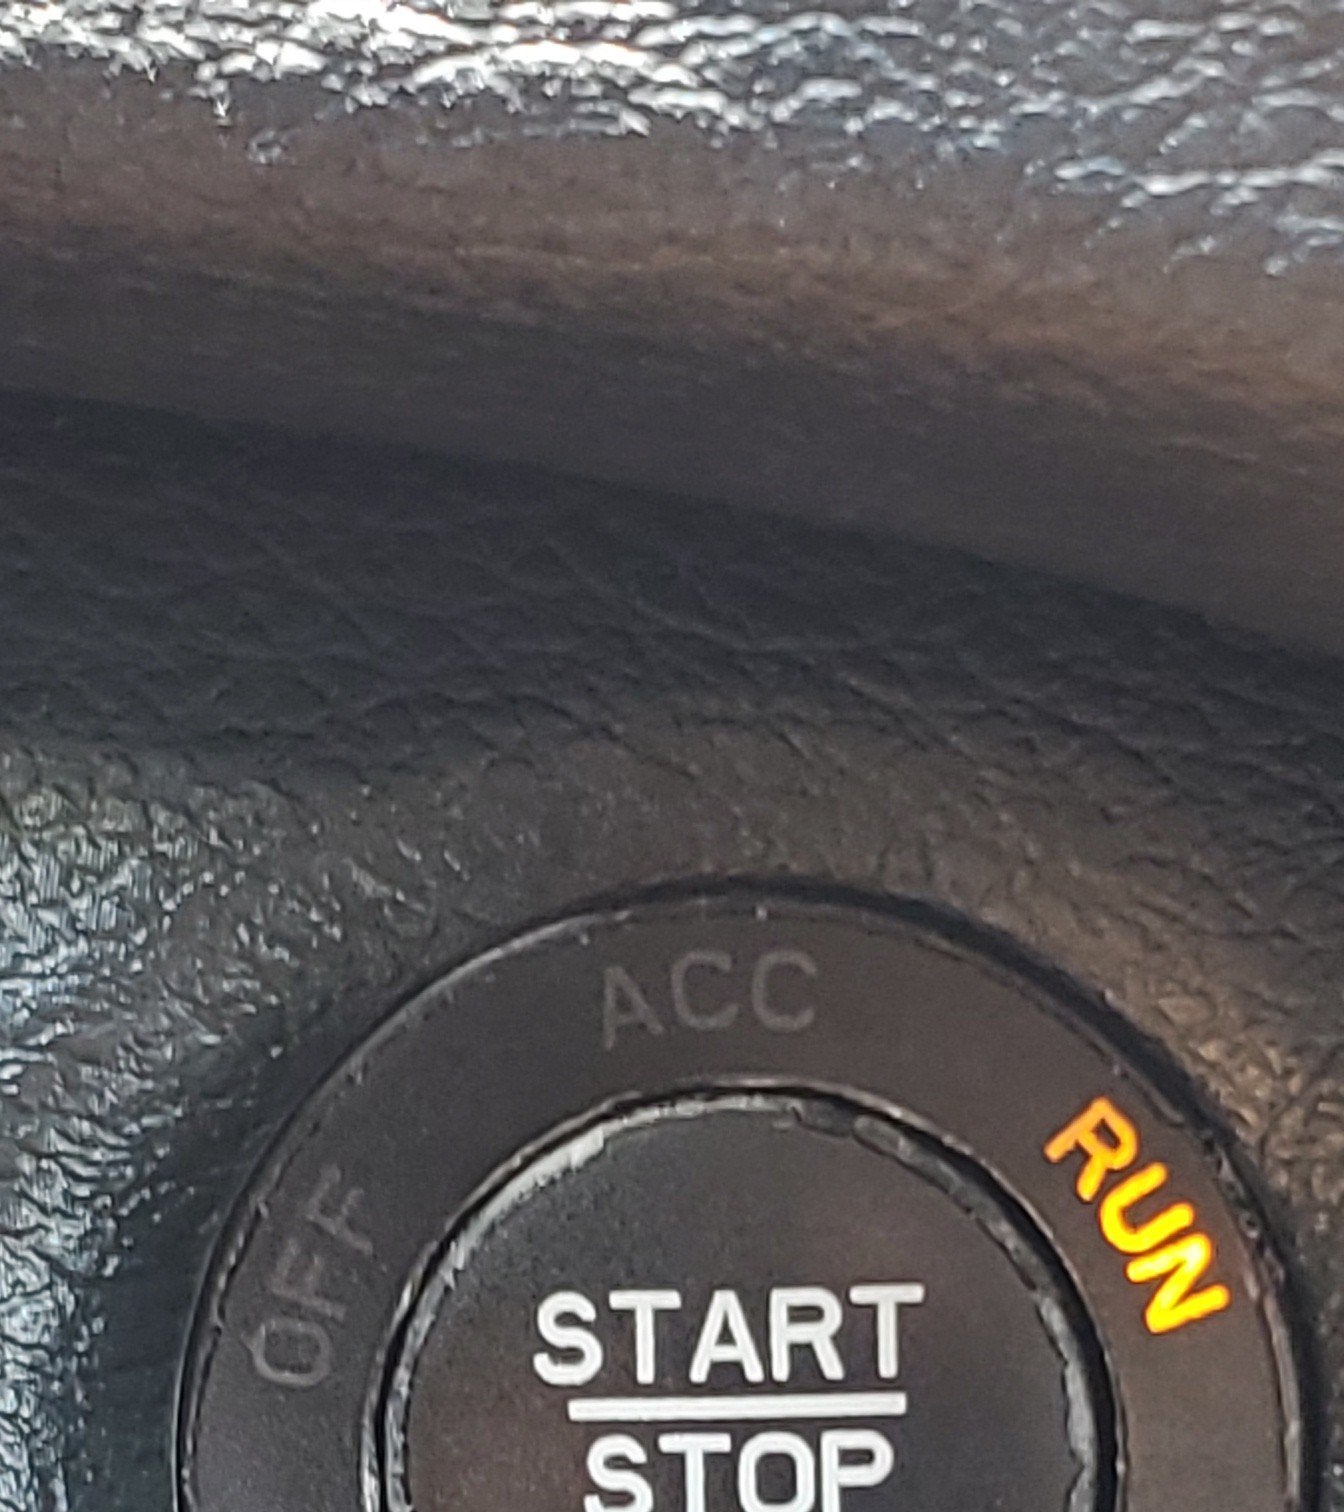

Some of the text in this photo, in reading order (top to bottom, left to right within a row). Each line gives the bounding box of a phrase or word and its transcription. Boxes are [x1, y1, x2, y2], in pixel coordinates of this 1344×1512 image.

[600, 949, 818, 1052] ACC
[250, 1163, 374, 1388] OFF
[1042, 1094, 1233, 1336] RUN
[531, 1282, 927, 1386] START
